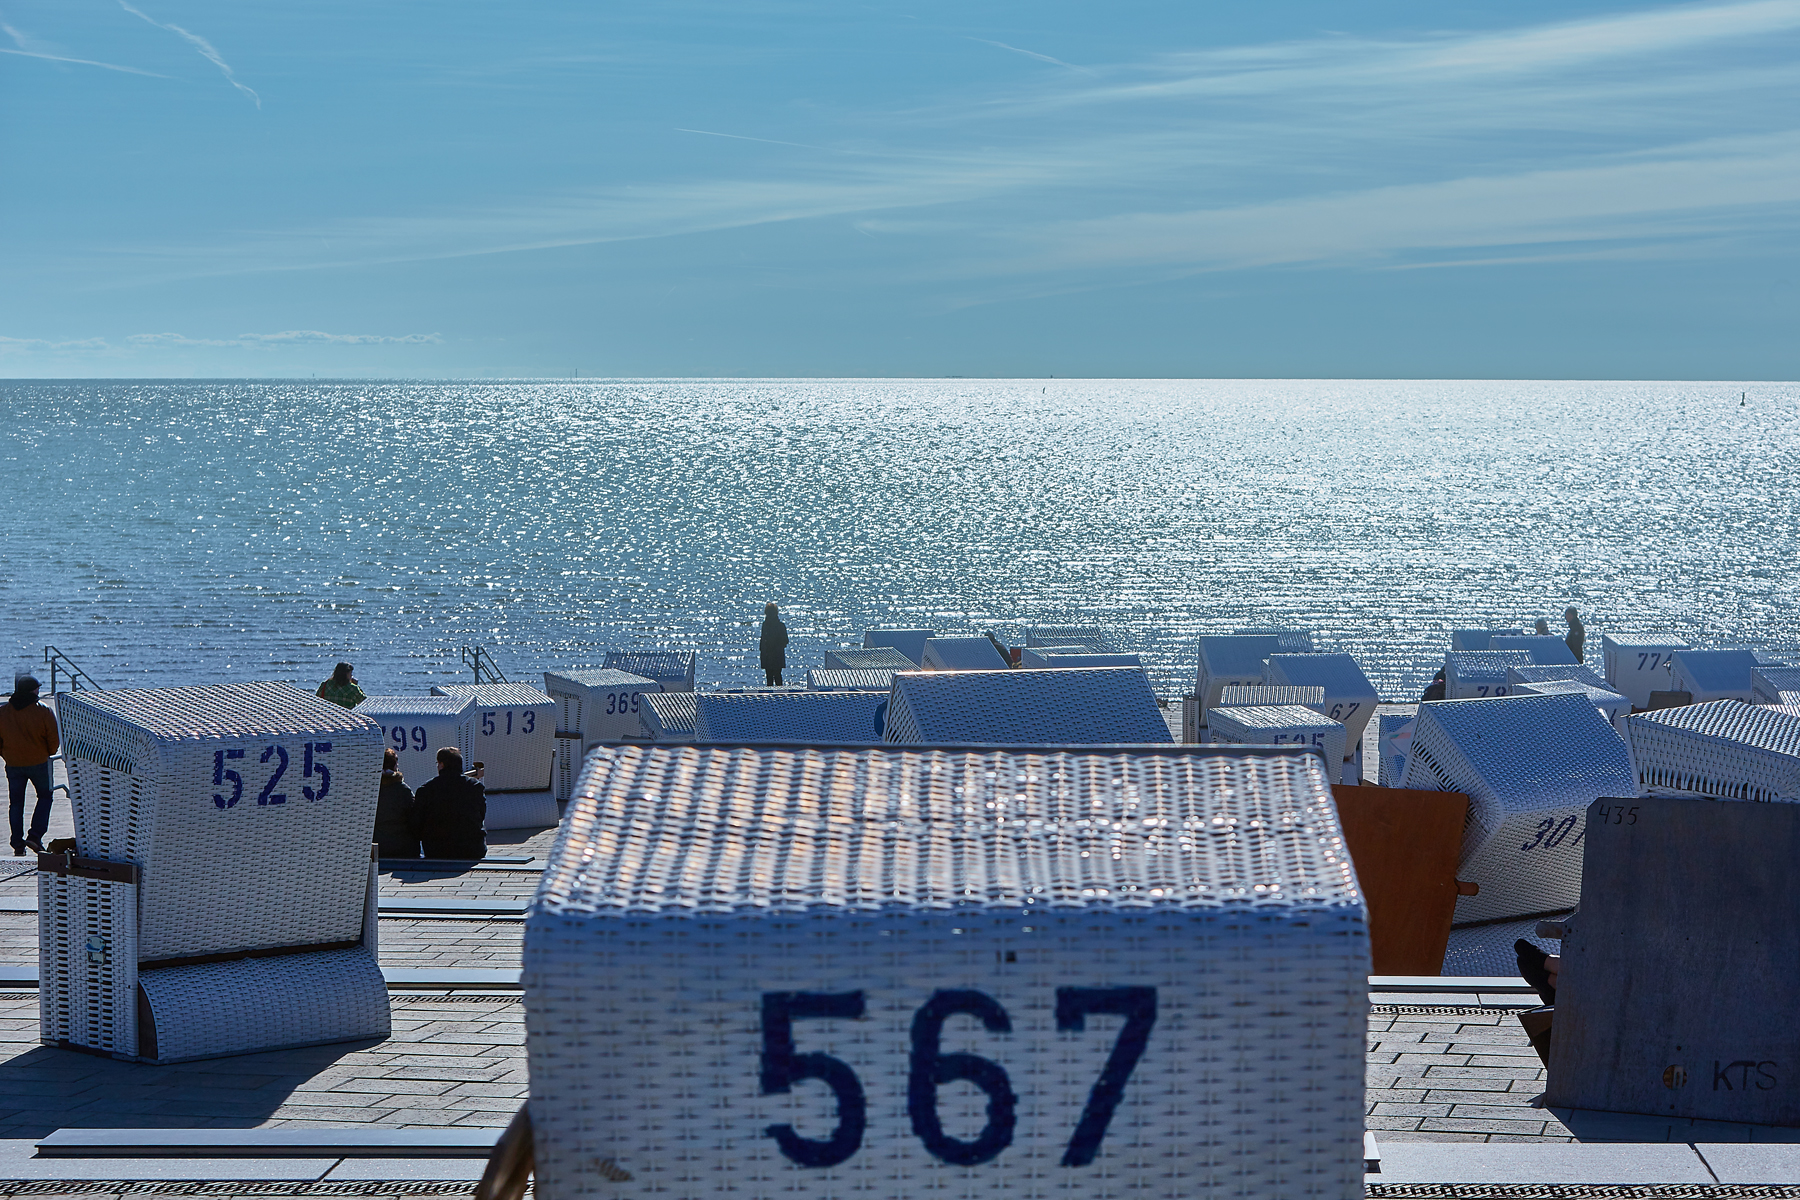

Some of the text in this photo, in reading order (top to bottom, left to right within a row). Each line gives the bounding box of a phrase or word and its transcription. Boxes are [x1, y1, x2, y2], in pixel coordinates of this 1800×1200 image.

[606, 691, 639, 715] 369
[481, 710, 536, 737] 513
[381, 725, 428, 752] 99
[212, 741, 334, 810] 525
[1598, 804, 1640, 826] 435
[760, 986, 1158, 1168] 567
[1712, 1060, 1778, 1092] KTS
